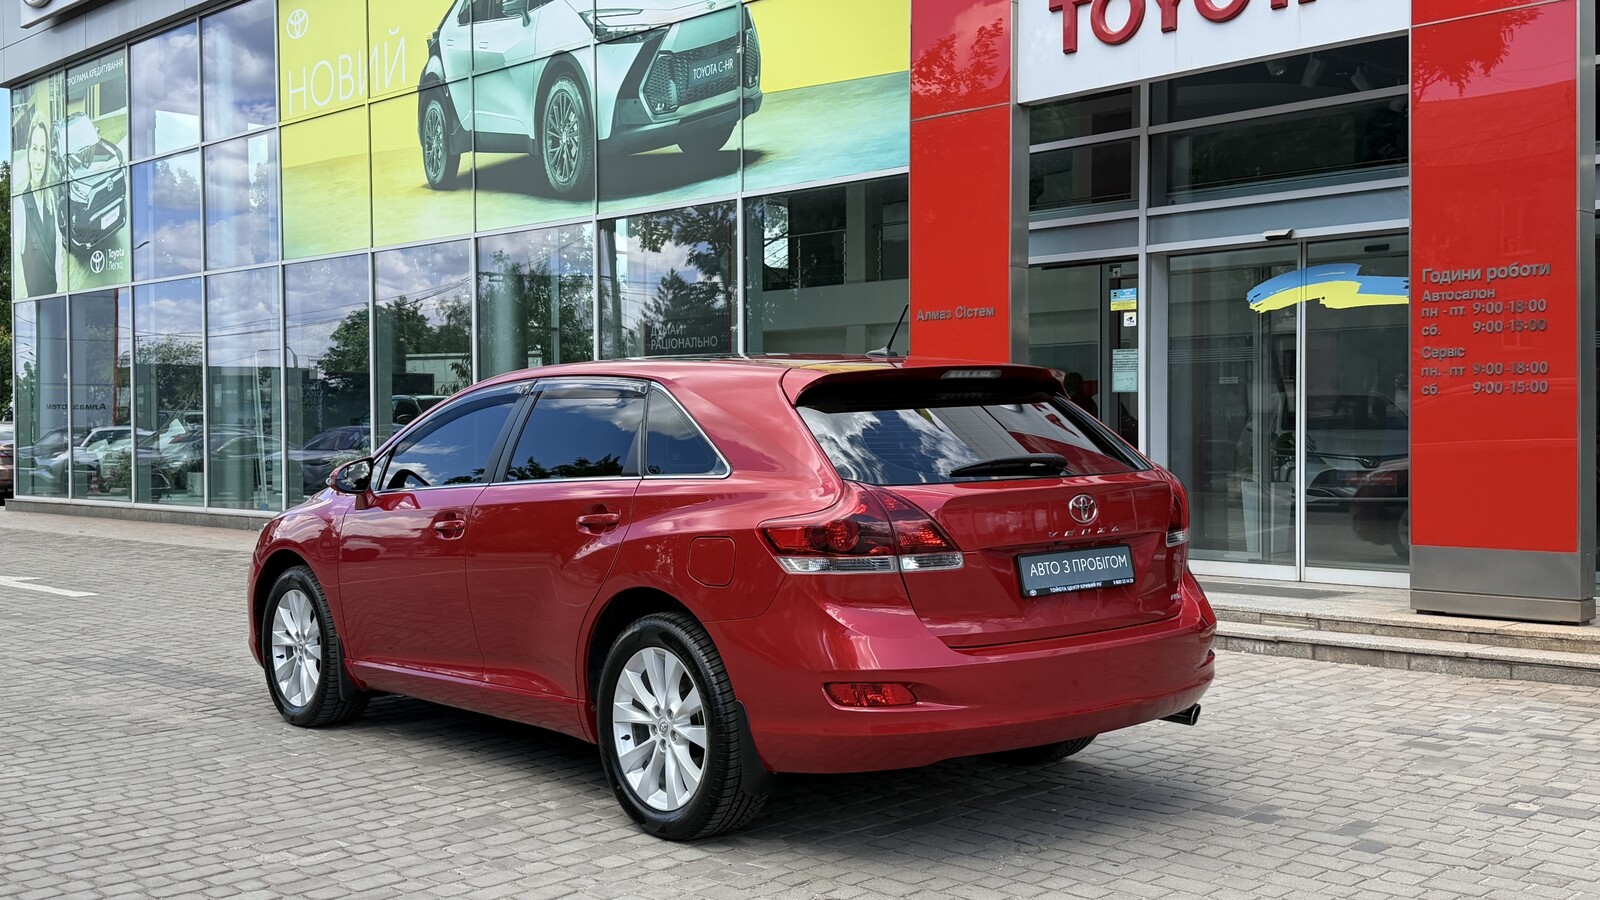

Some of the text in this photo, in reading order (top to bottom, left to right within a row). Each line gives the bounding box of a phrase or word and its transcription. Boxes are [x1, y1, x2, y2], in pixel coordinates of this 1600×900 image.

[67, 58, 124, 86] РОГРАМА КРЕДИТУВАННЯ
[287, 26, 405, 114] НОВИЙ
[693, 58, 734, 79] TOYOTA C-HR
[108, 248, 125, 260] Toyota
[1422, 262, 1551, 284] Години роботи
[1421, 289, 1496, 302] Автосалон
[917, 306, 995, 321] Алмаз Сістем
[1421, 307, 1438, 317] пн
[1421, 324, 1441, 336] сб.
[651, 336, 718, 351] РАЦІОНАЛЬНО
[1421, 346, 1465, 360] Сервіс
[1421, 383, 1441, 395] сб.
[1048, 526, 1119, 538] VENZA
[1030, 561, 1061, 577] АВТО
[1072, 554, 1128, 572] ПРОБІГОМ
